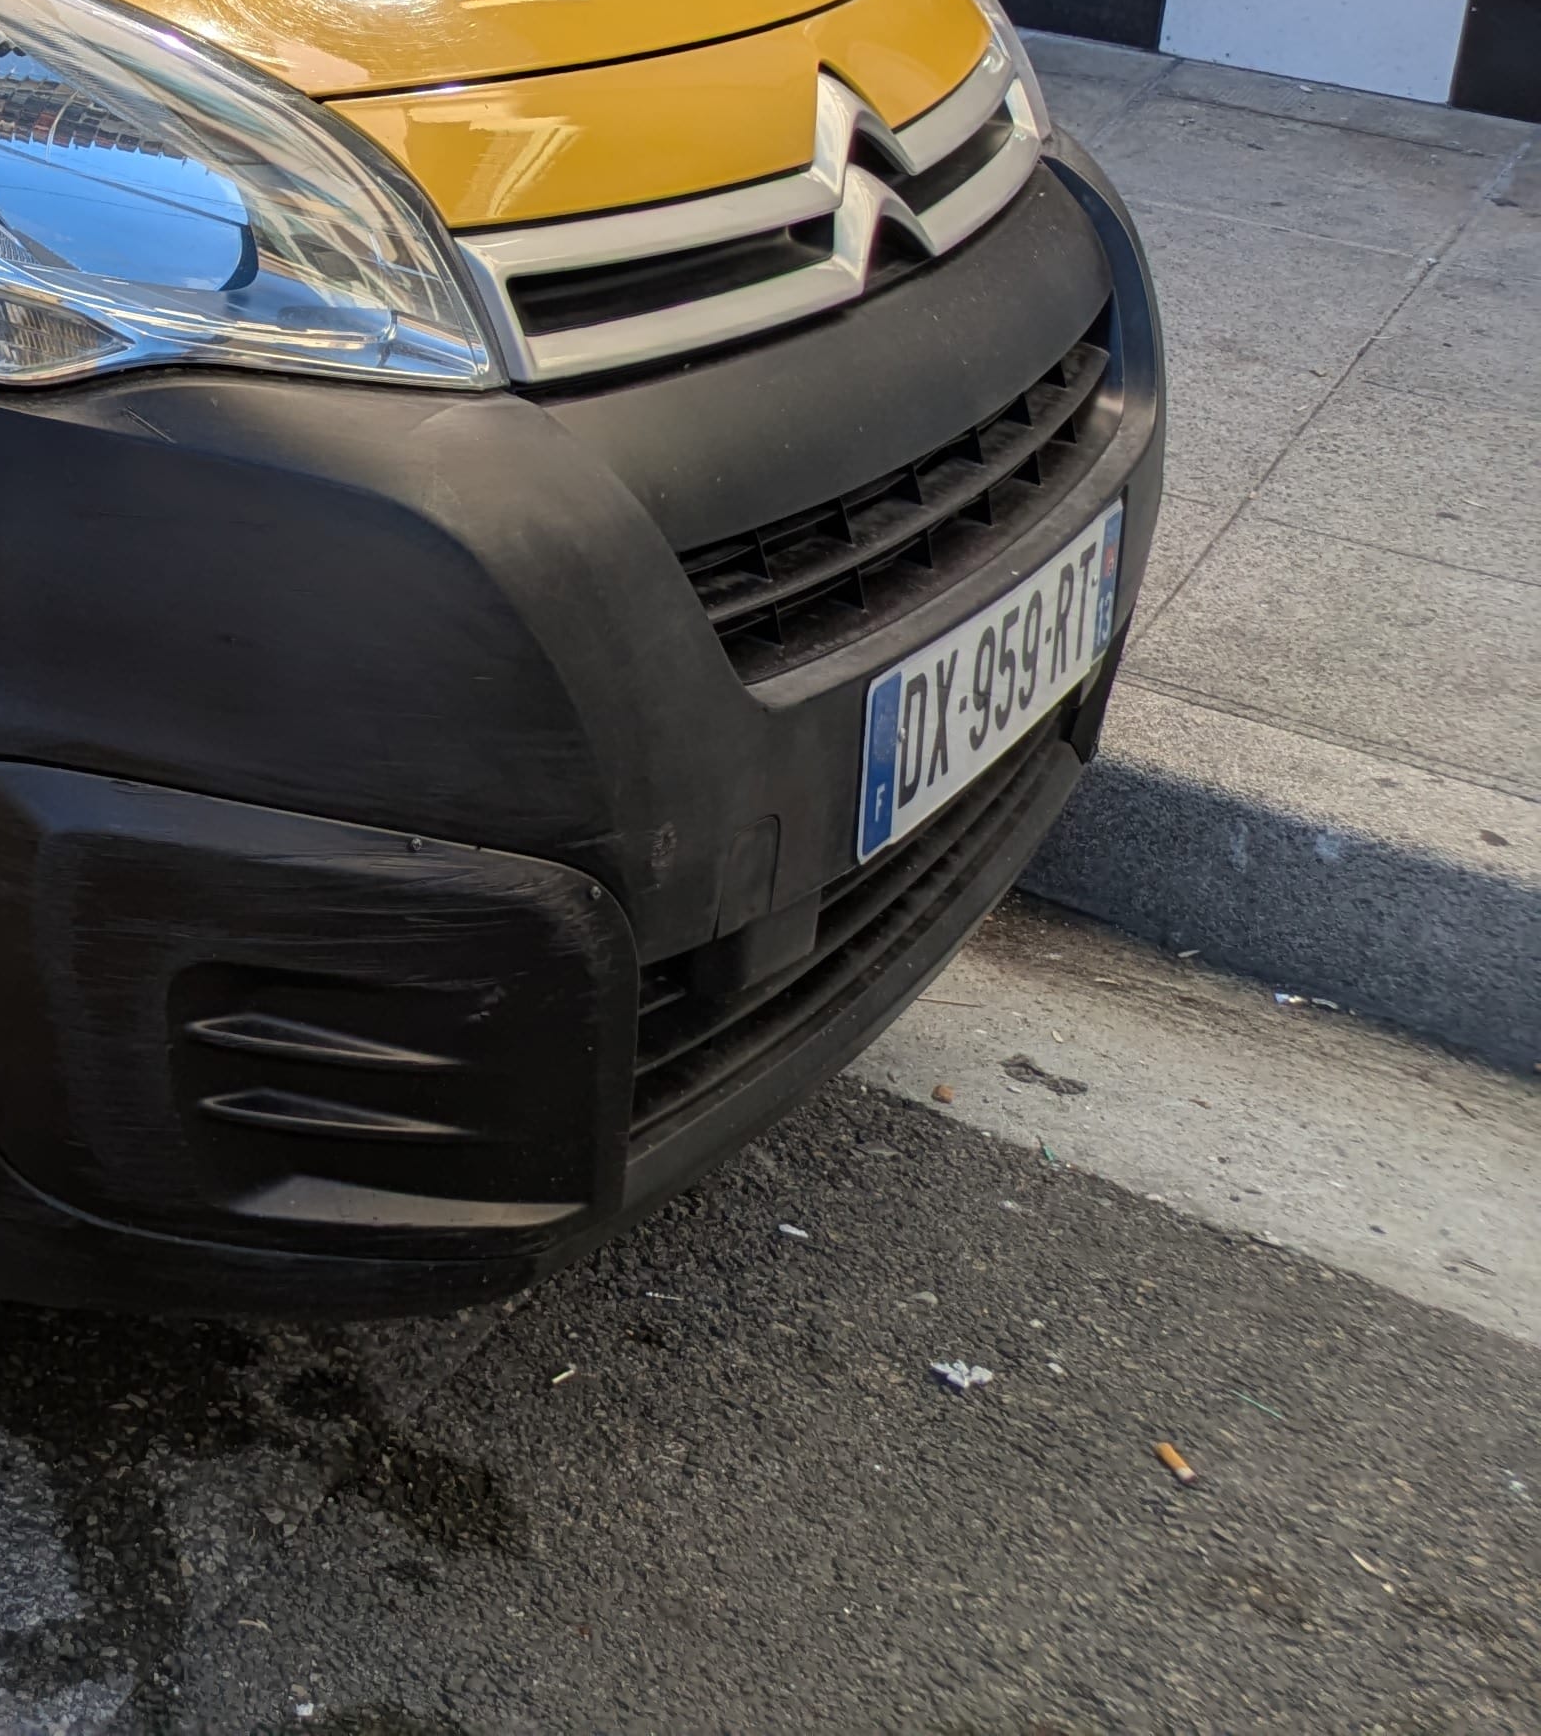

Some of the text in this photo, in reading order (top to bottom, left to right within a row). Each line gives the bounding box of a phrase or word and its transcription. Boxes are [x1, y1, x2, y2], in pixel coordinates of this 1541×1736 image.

[874, 541, 1112, 823] F DX-959-RT 13
